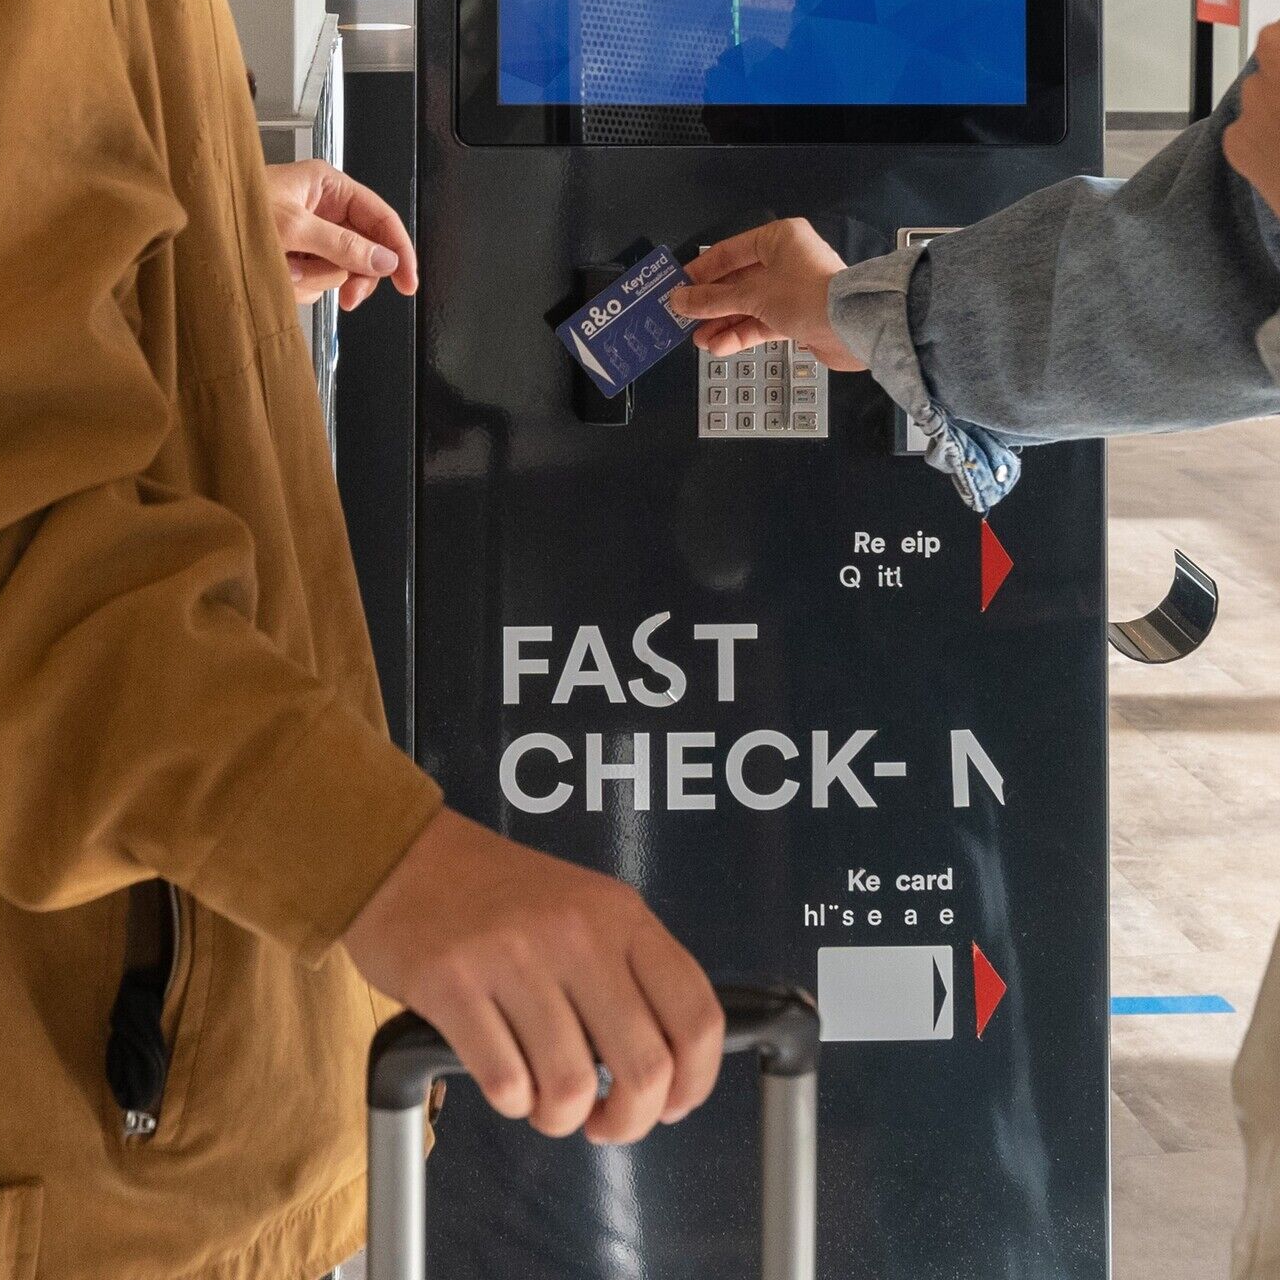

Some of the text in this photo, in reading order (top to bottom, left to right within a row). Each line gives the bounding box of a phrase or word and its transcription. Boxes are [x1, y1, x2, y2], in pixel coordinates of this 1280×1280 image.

[621, 253, 669, 294] KeyCard
[581, 299, 622, 337] a&o
[770, 340, 779, 350] 3
[715, 366, 722, 375] 4
[743, 366, 750, 375] 5
[770, 365, 778, 375] 6
[714, 390, 722, 401] 7
[742, 390, 750, 401] 8
[770, 390, 778, 401] 9
[742, 417, 751, 426] 0
[502, 611, 759, 708] FAST
